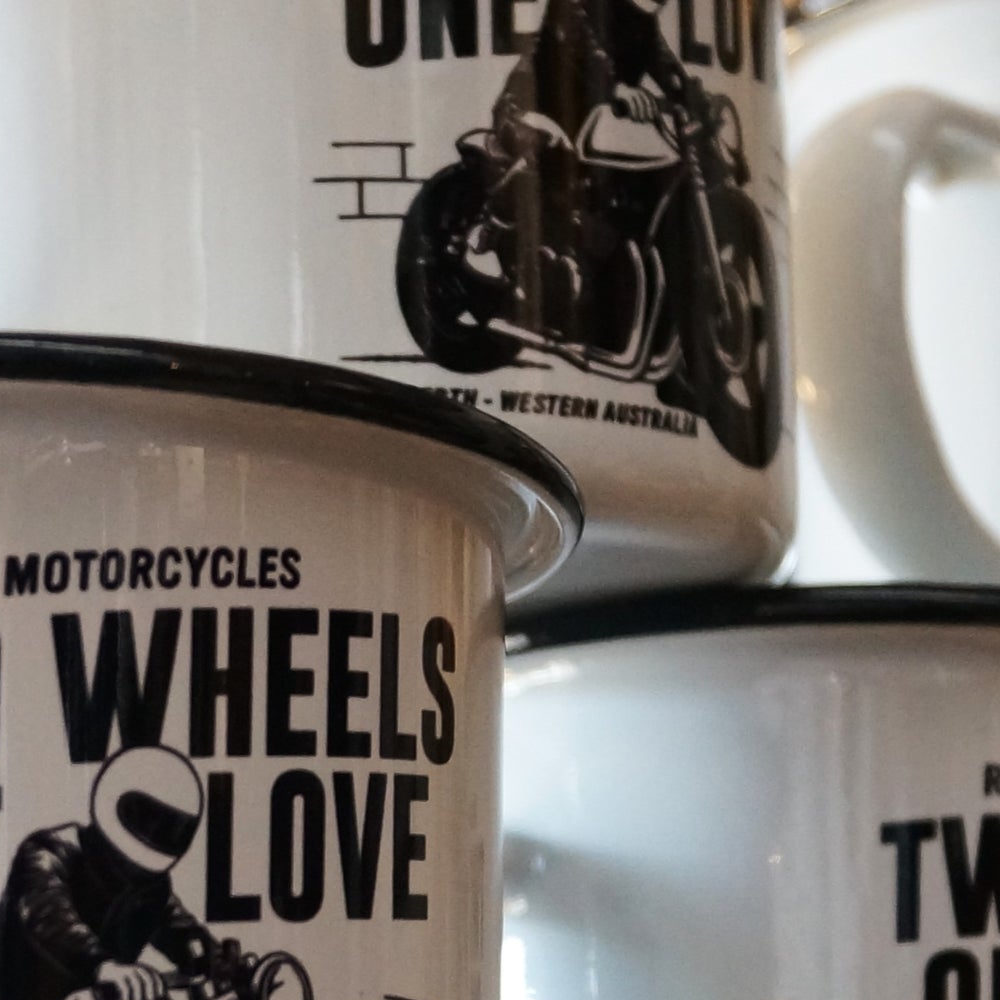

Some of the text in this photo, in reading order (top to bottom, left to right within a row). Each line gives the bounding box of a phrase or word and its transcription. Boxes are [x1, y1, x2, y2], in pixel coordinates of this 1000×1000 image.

[501, 389, 599, 419] WESTERN
[603, 400, 698, 437] AUSTRALIA
[3, 546, 302, 597] MOTORCYCLES
[50, 606, 457, 766] WHEELS
[205, 768, 430, 922] LOVE
[880, 812, 1000, 943] TW
